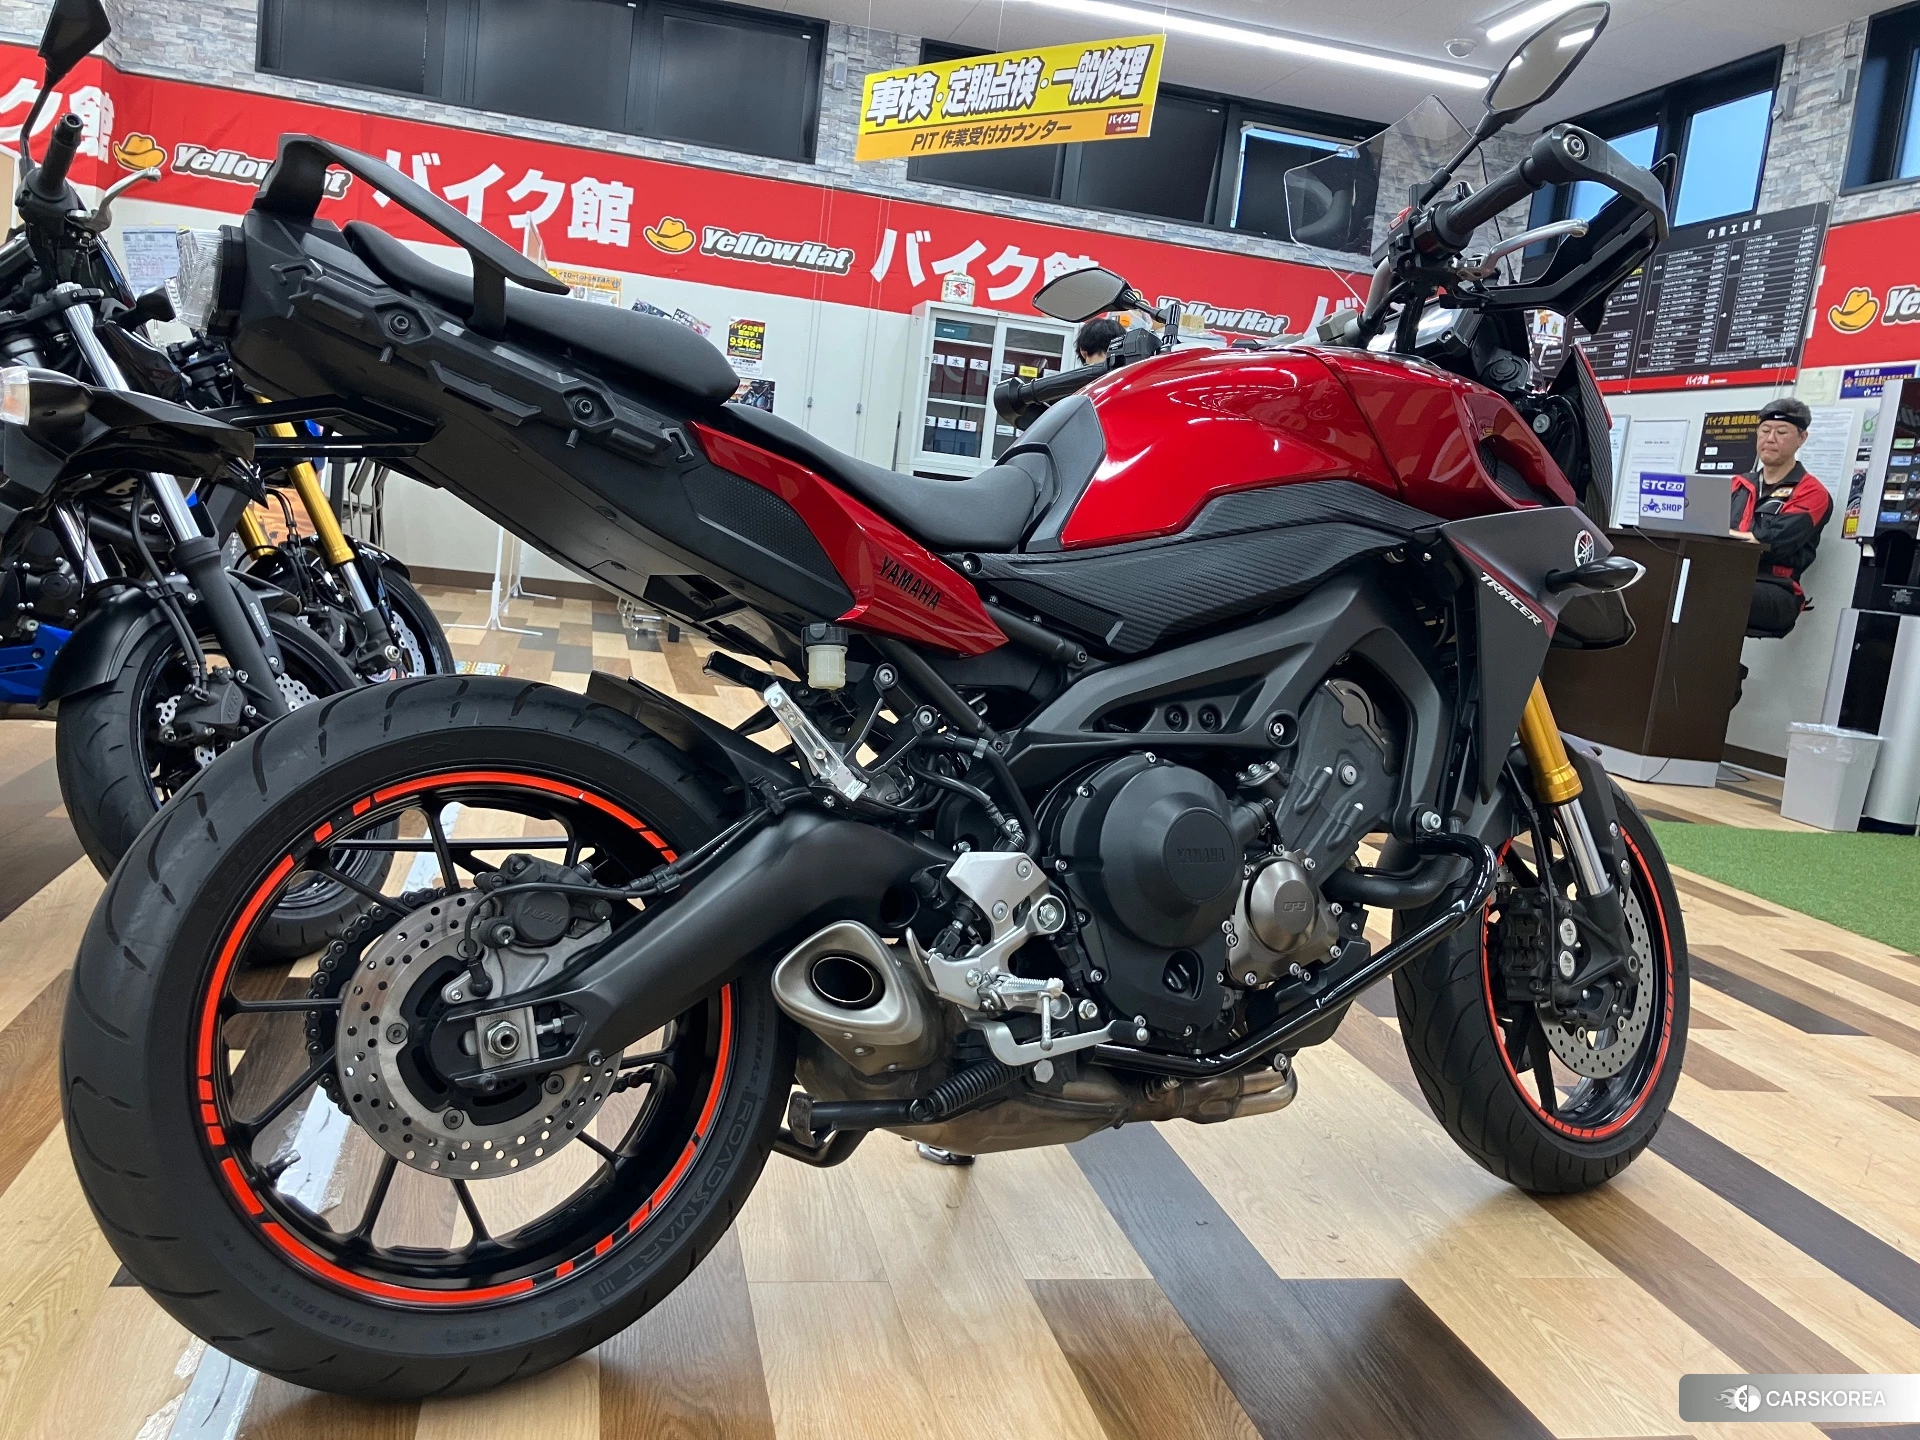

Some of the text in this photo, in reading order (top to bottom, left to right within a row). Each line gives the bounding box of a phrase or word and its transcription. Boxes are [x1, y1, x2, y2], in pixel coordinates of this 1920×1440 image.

[865, 45, 1153, 124] 車検・定期点検・一般修理
[911, 120, 1072, 151] PIT 作業受付カウンター
[372, 149, 634, 247] バイク館
[701, 226, 855, 275] YellowHat
[952, 358, 960, 366] 水
[975, 360, 983, 368] 木
[1662, 503, 1682, 512] SHOP
[880, 555, 942, 611] YAMAHA
[1480, 571, 1543, 627] TRACER
[626, 1099, 755, 1280] ROADSMART
